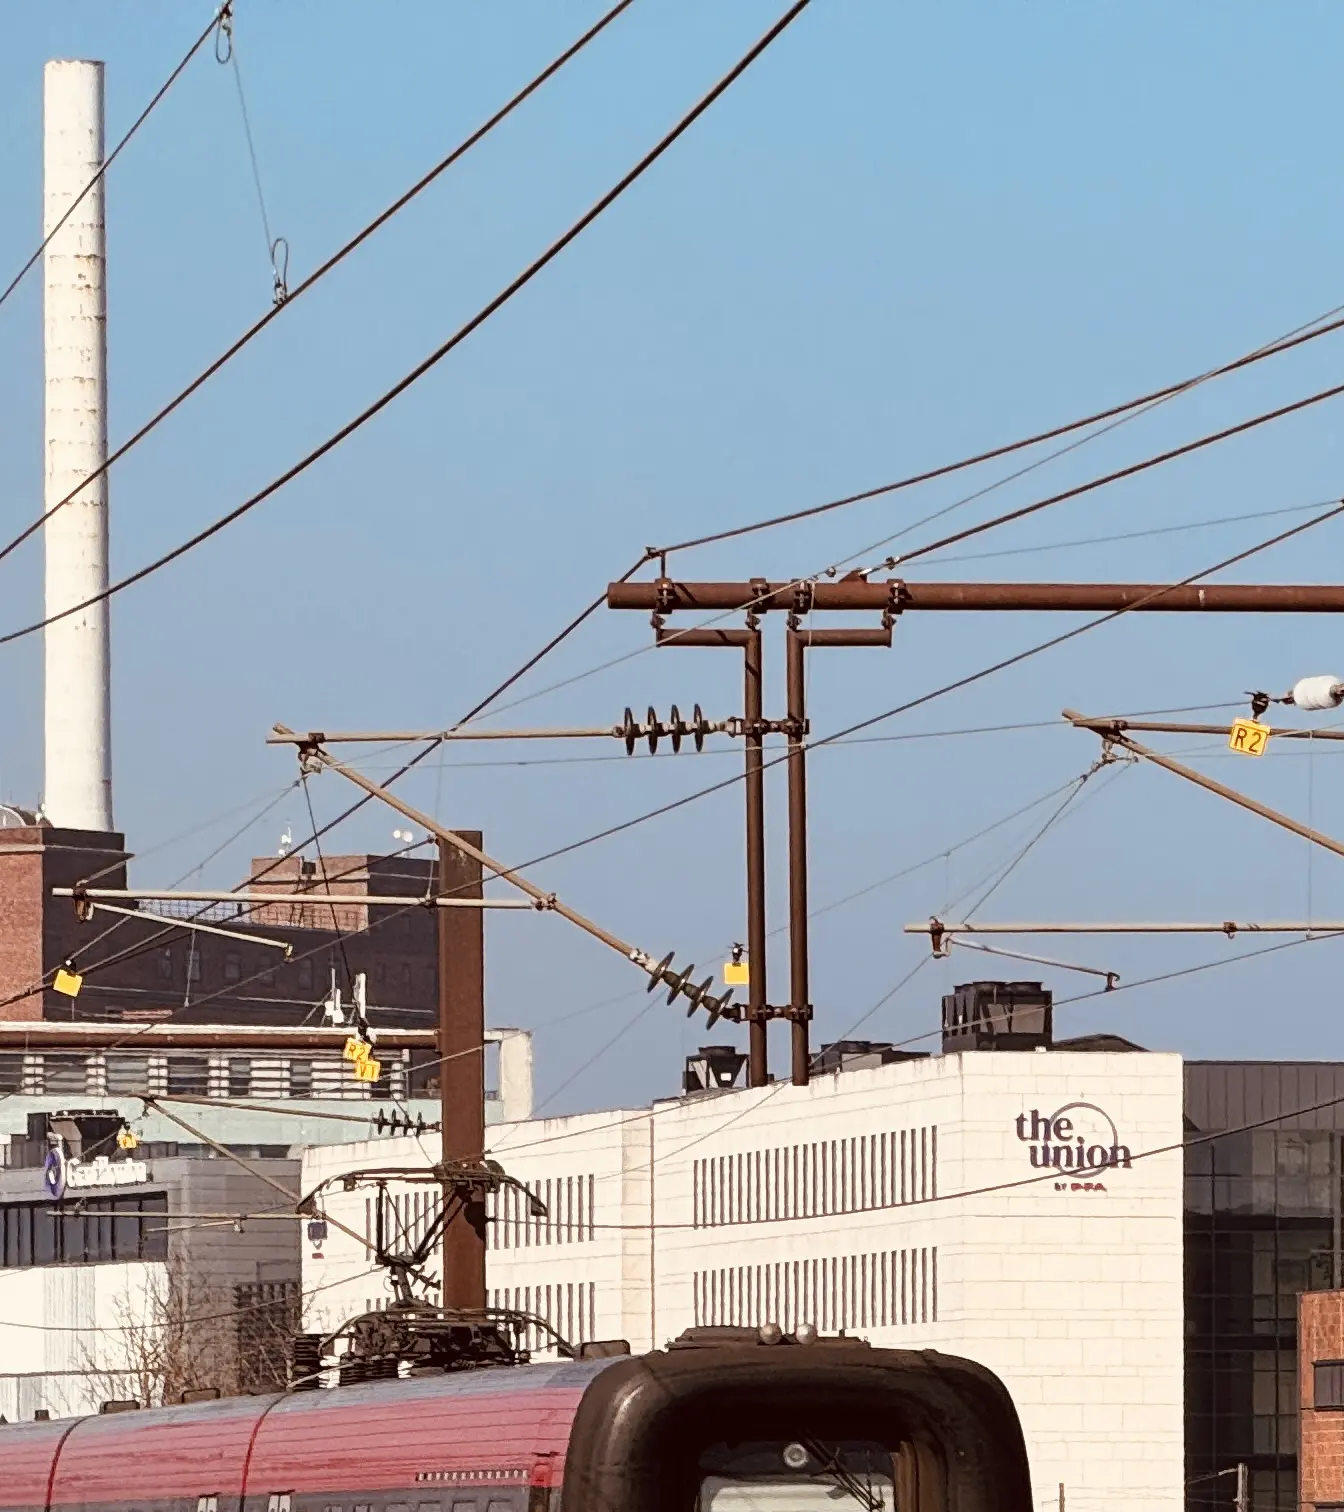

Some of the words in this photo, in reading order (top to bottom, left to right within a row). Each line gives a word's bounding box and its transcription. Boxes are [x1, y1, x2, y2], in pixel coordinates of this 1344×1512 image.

[1234, 727, 1262, 753] R2
[1014, 1108, 1074, 1142] the
[1028, 1136, 1133, 1169] union
